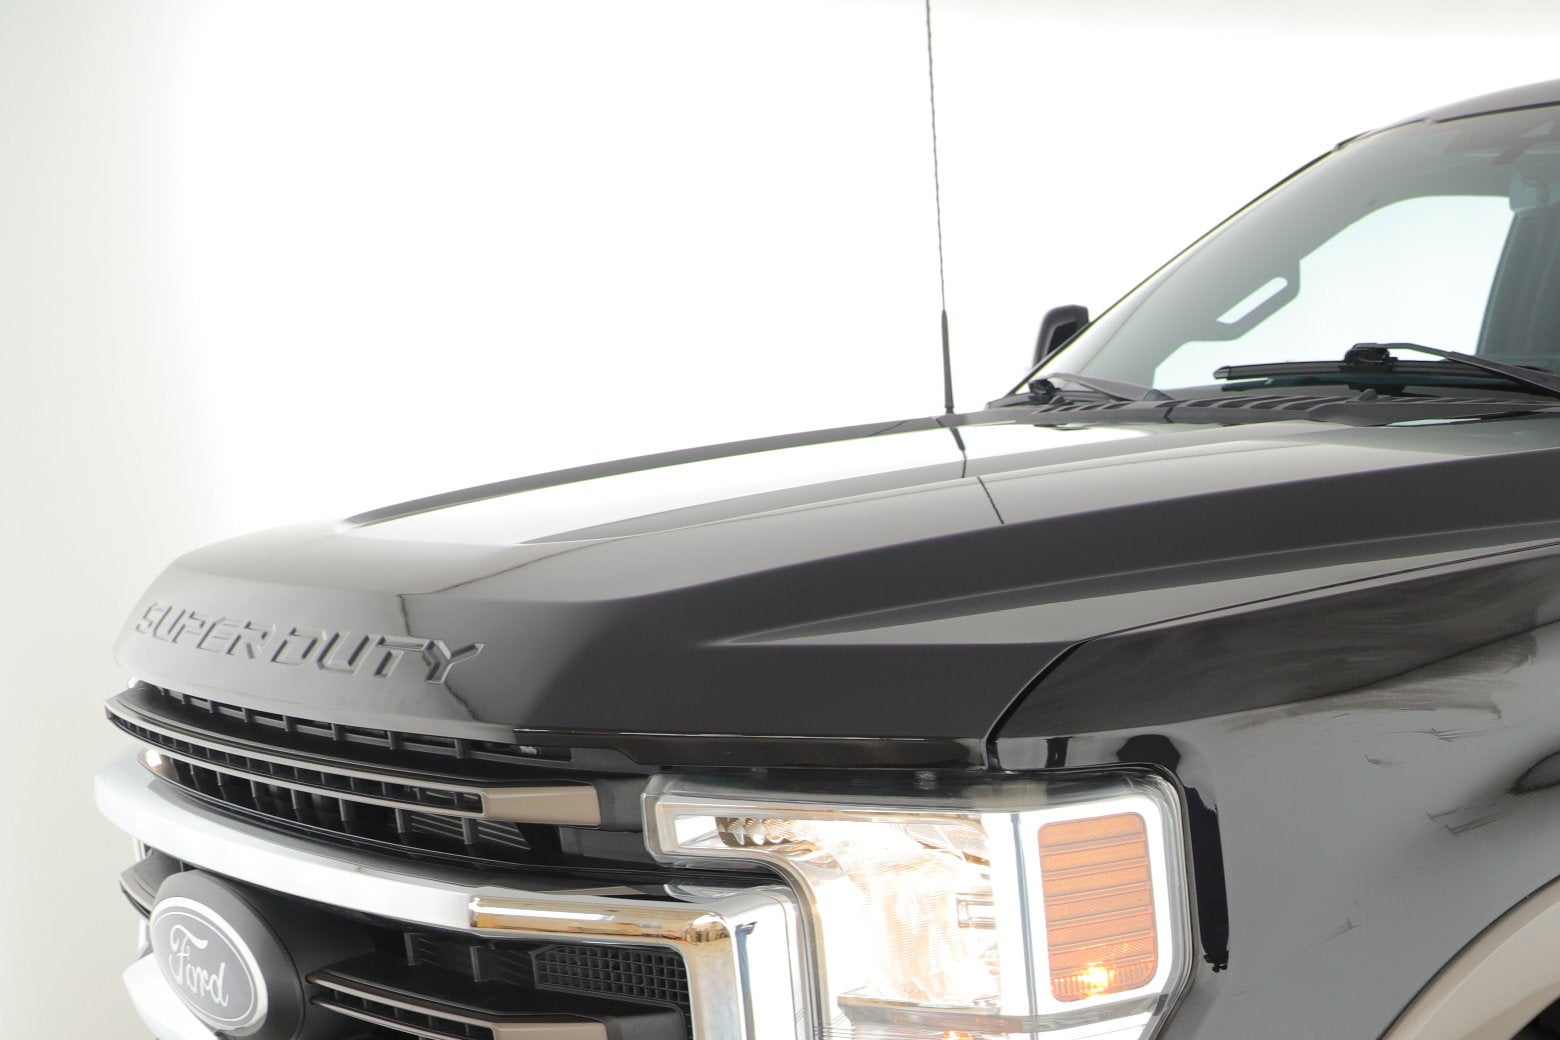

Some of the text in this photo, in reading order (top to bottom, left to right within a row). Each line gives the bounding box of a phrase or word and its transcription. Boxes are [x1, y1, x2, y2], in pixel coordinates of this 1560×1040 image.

[135, 602, 485, 684] SUPER DUTY
[168, 924, 229, 1007] Ford
